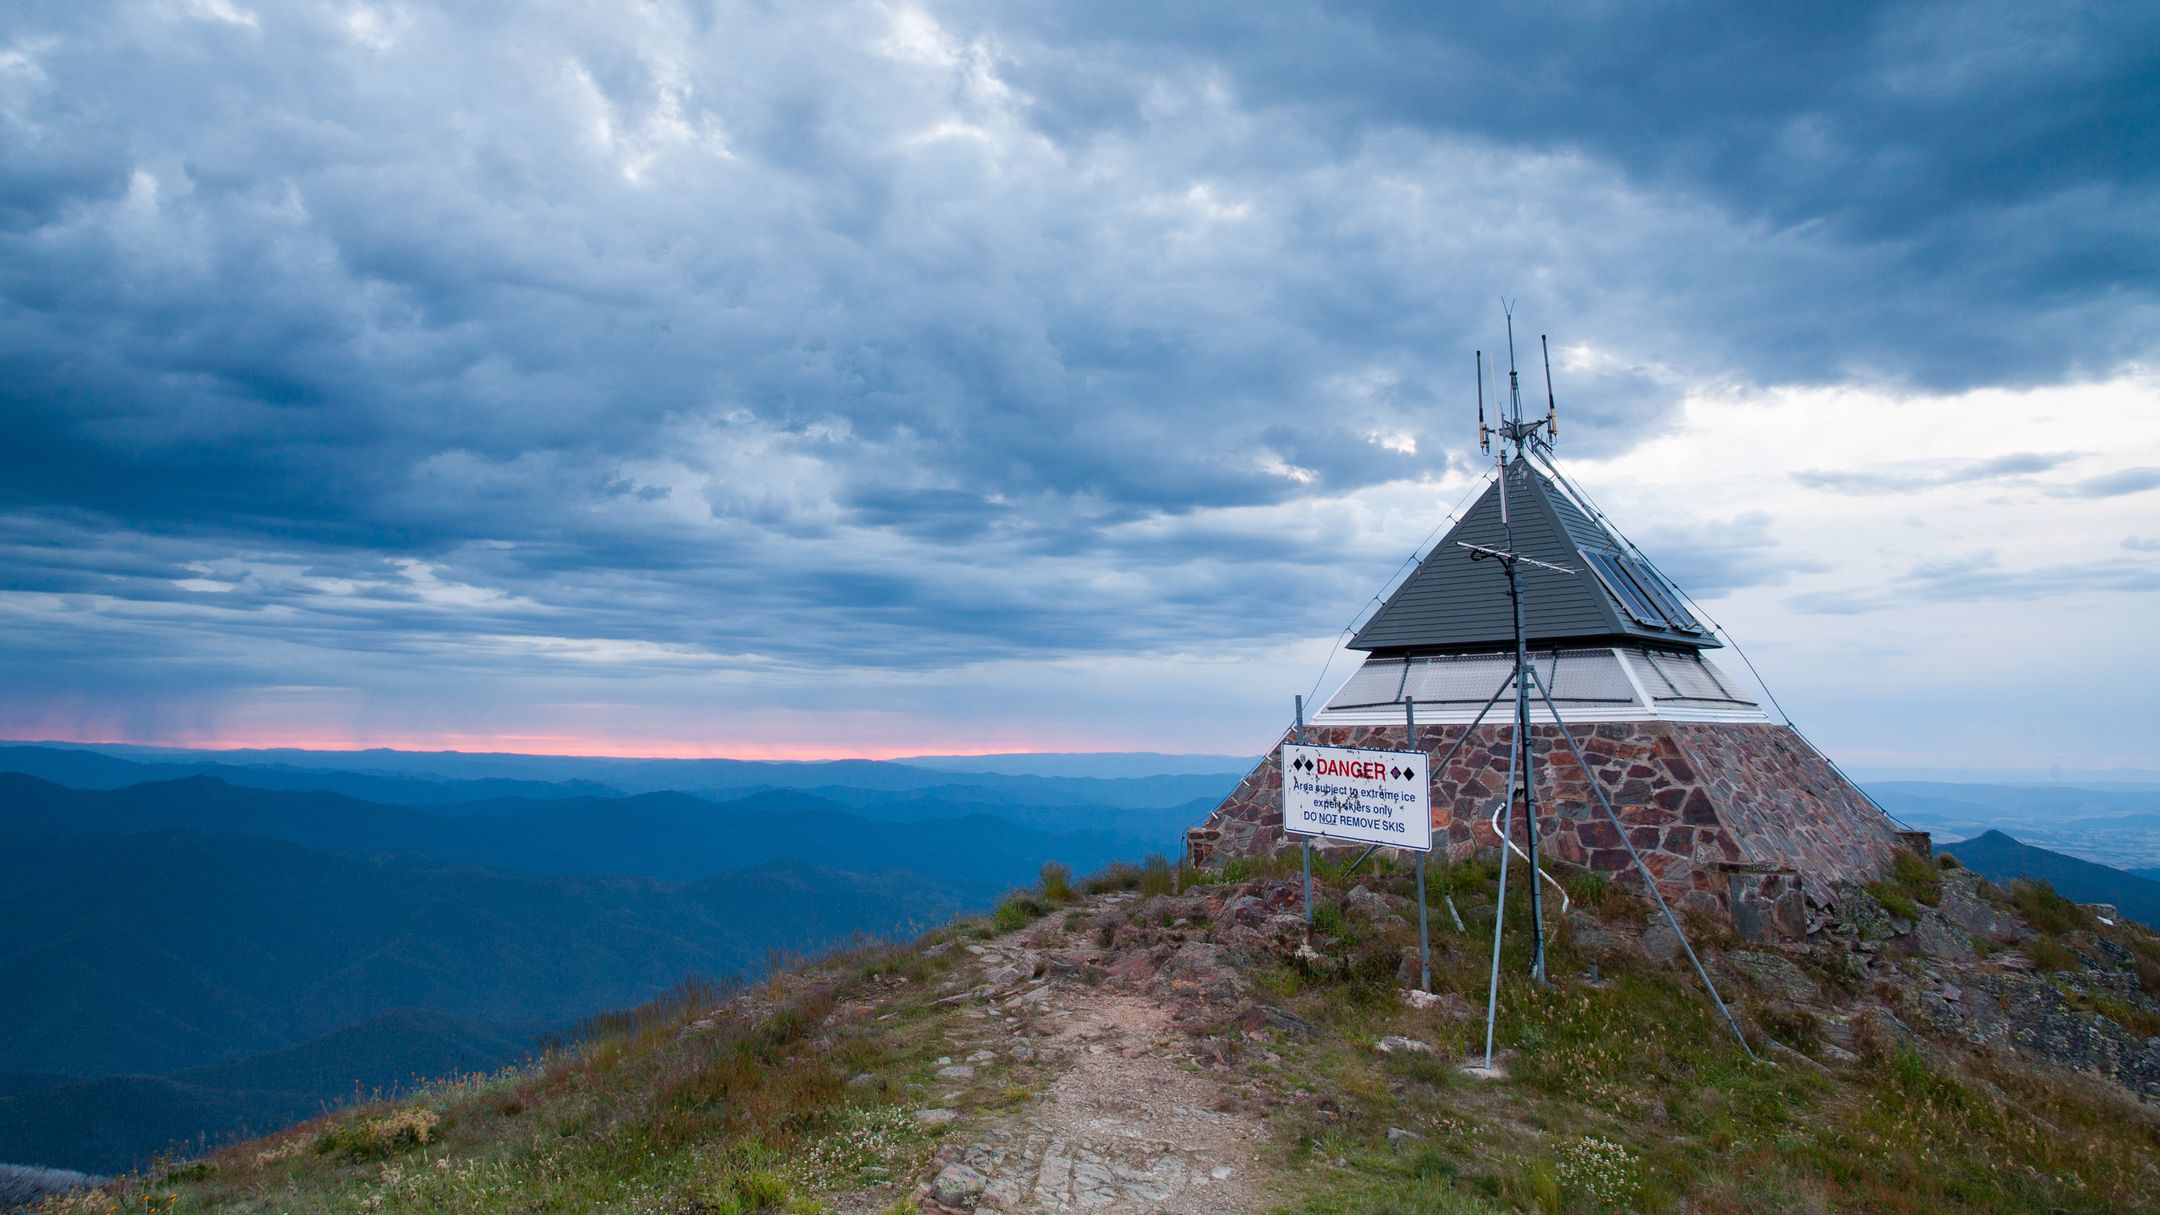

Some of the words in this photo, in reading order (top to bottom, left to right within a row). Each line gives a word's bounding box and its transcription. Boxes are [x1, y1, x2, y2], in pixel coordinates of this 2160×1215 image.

[1317, 758, 1386, 780] DANGER
[1294, 781, 1313, 791] Area
[1316, 783, 1347, 795] subject
[1350, 787, 1358, 796] to
[1361, 789, 1399, 801] extreme
[1401, 793, 1415, 802] ice
[1314, 799, 1341, 810] expert
[1344, 802, 1370, 813] skiers
[1374, 805, 1392, 817] only
[1304, 811, 1317, 821] DO
[1319, 814, 1337, 823] NOT
[1340, 816, 1380, 829] REMOVE
[1382, 821, 1405, 832] SKIS
